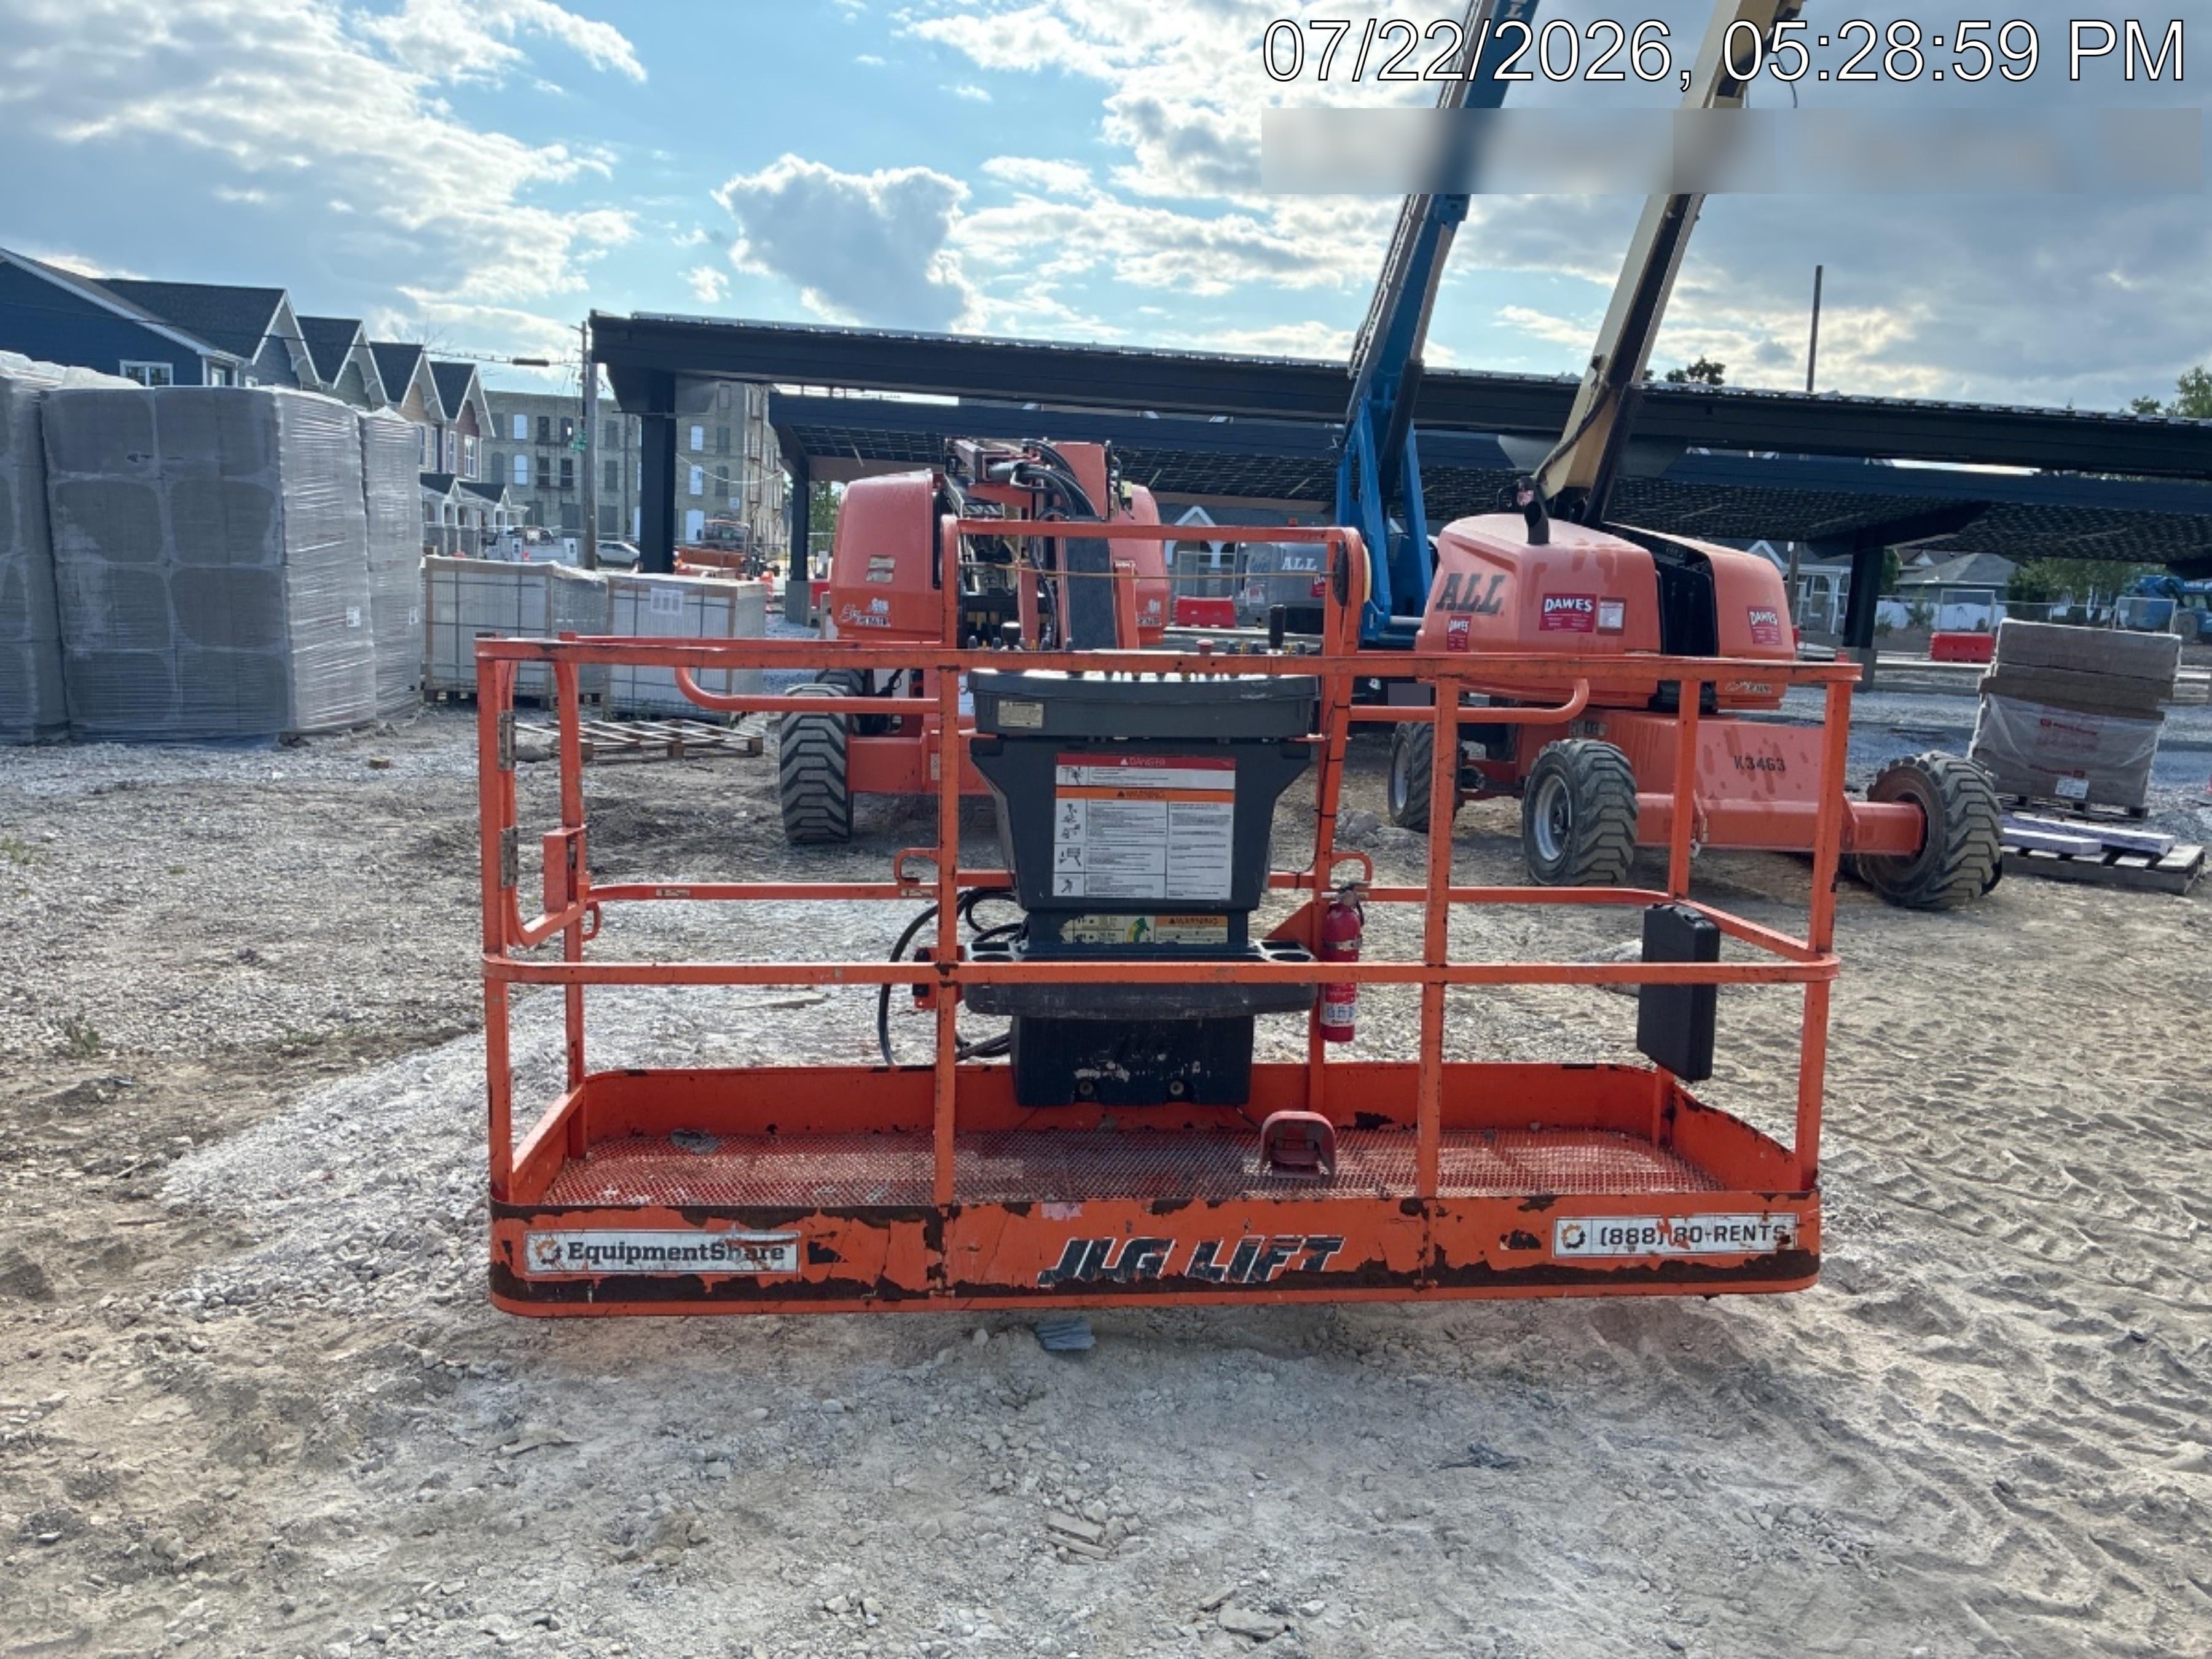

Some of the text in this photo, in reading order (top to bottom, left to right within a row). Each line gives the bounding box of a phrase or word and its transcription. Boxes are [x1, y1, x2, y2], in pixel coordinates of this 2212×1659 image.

[1281, 557, 1317, 571] ALL
[1433, 573, 1506, 614] ALL
[1543, 598, 1593, 613] DAWES
[1129, 756, 1166, 767] DANGER
[1733, 755, 1786, 772] K3463
[1600, 1226, 1665, 1245] (888)
[567, 1241, 786, 1265] EquipmentShare
[1037, 1236, 1177, 1288] JLG
[1183, 1234, 1347, 1284] LIFT
